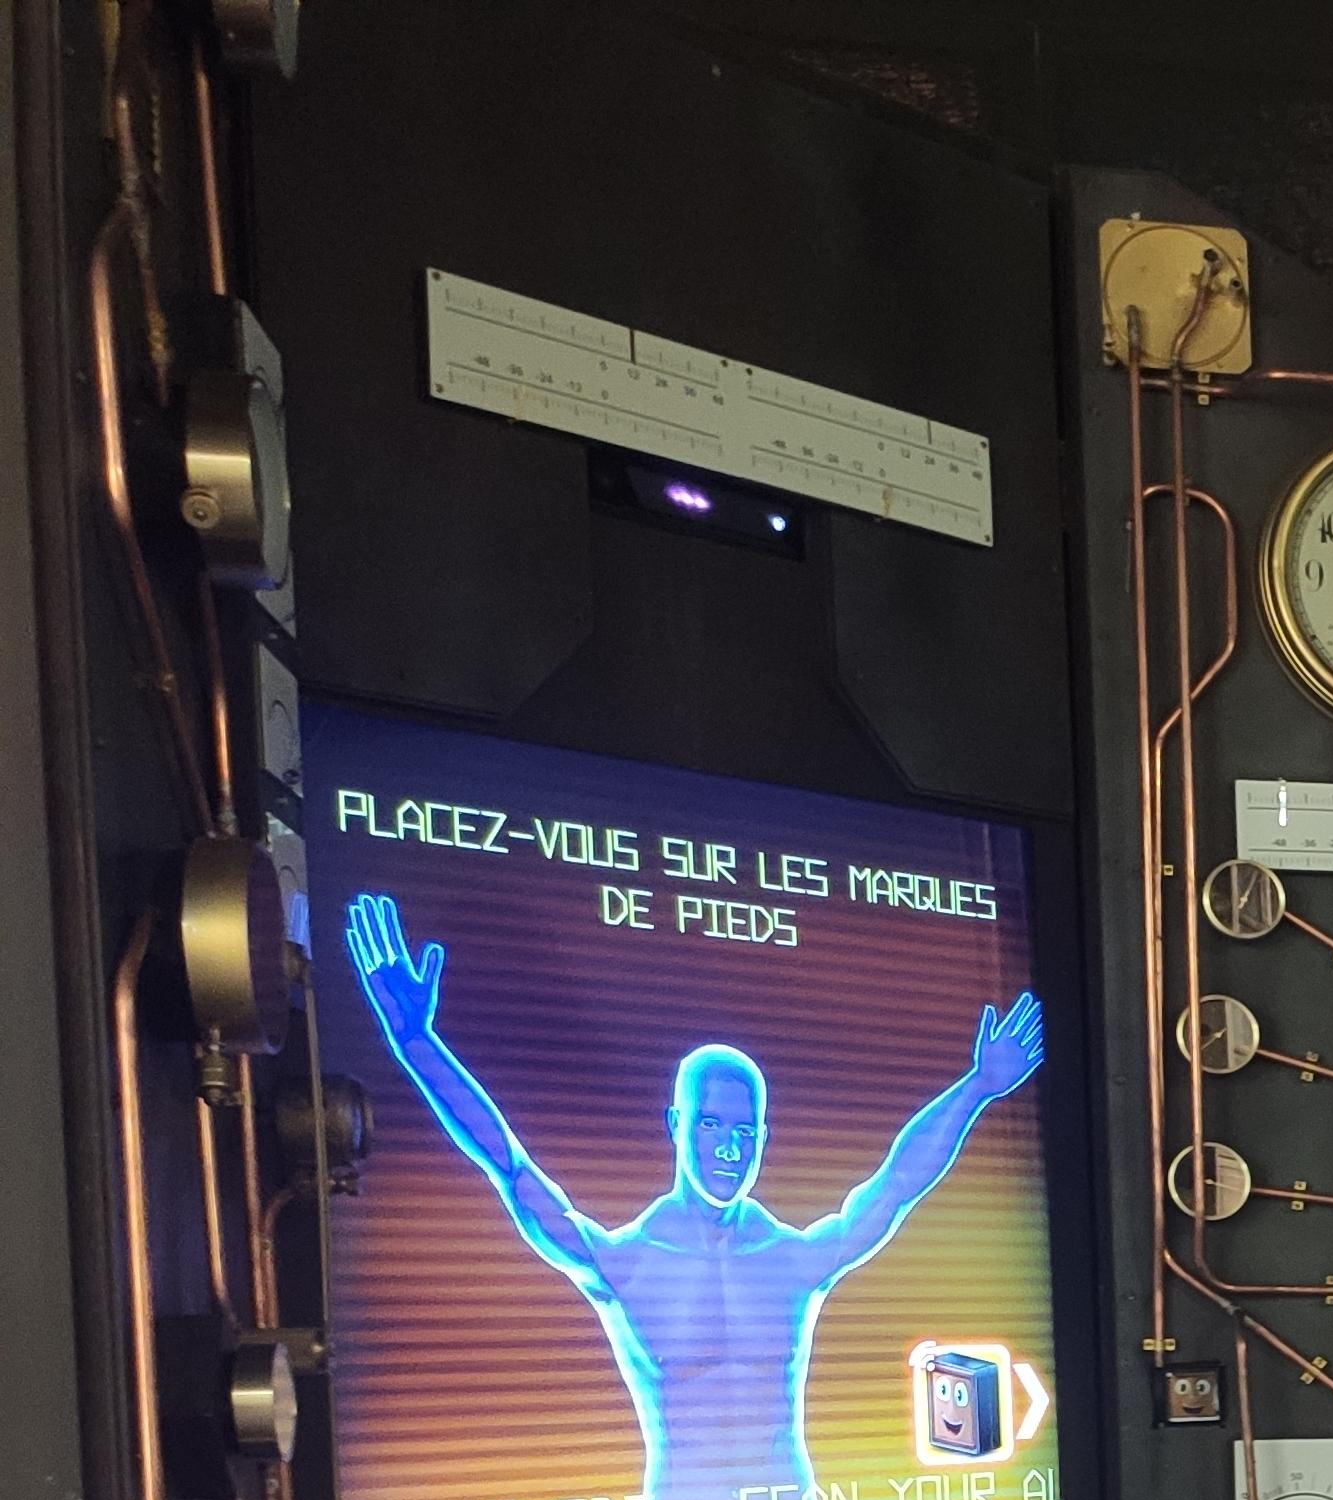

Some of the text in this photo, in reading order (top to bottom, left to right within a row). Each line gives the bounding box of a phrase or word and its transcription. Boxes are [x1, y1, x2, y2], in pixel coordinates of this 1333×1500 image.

[1304, 558, 1324, 592] 9
[338, 789, 997, 920] PLACEZ-VOUS SUR LES MARQUES
[602, 885, 798, 947] DE PIEDS
